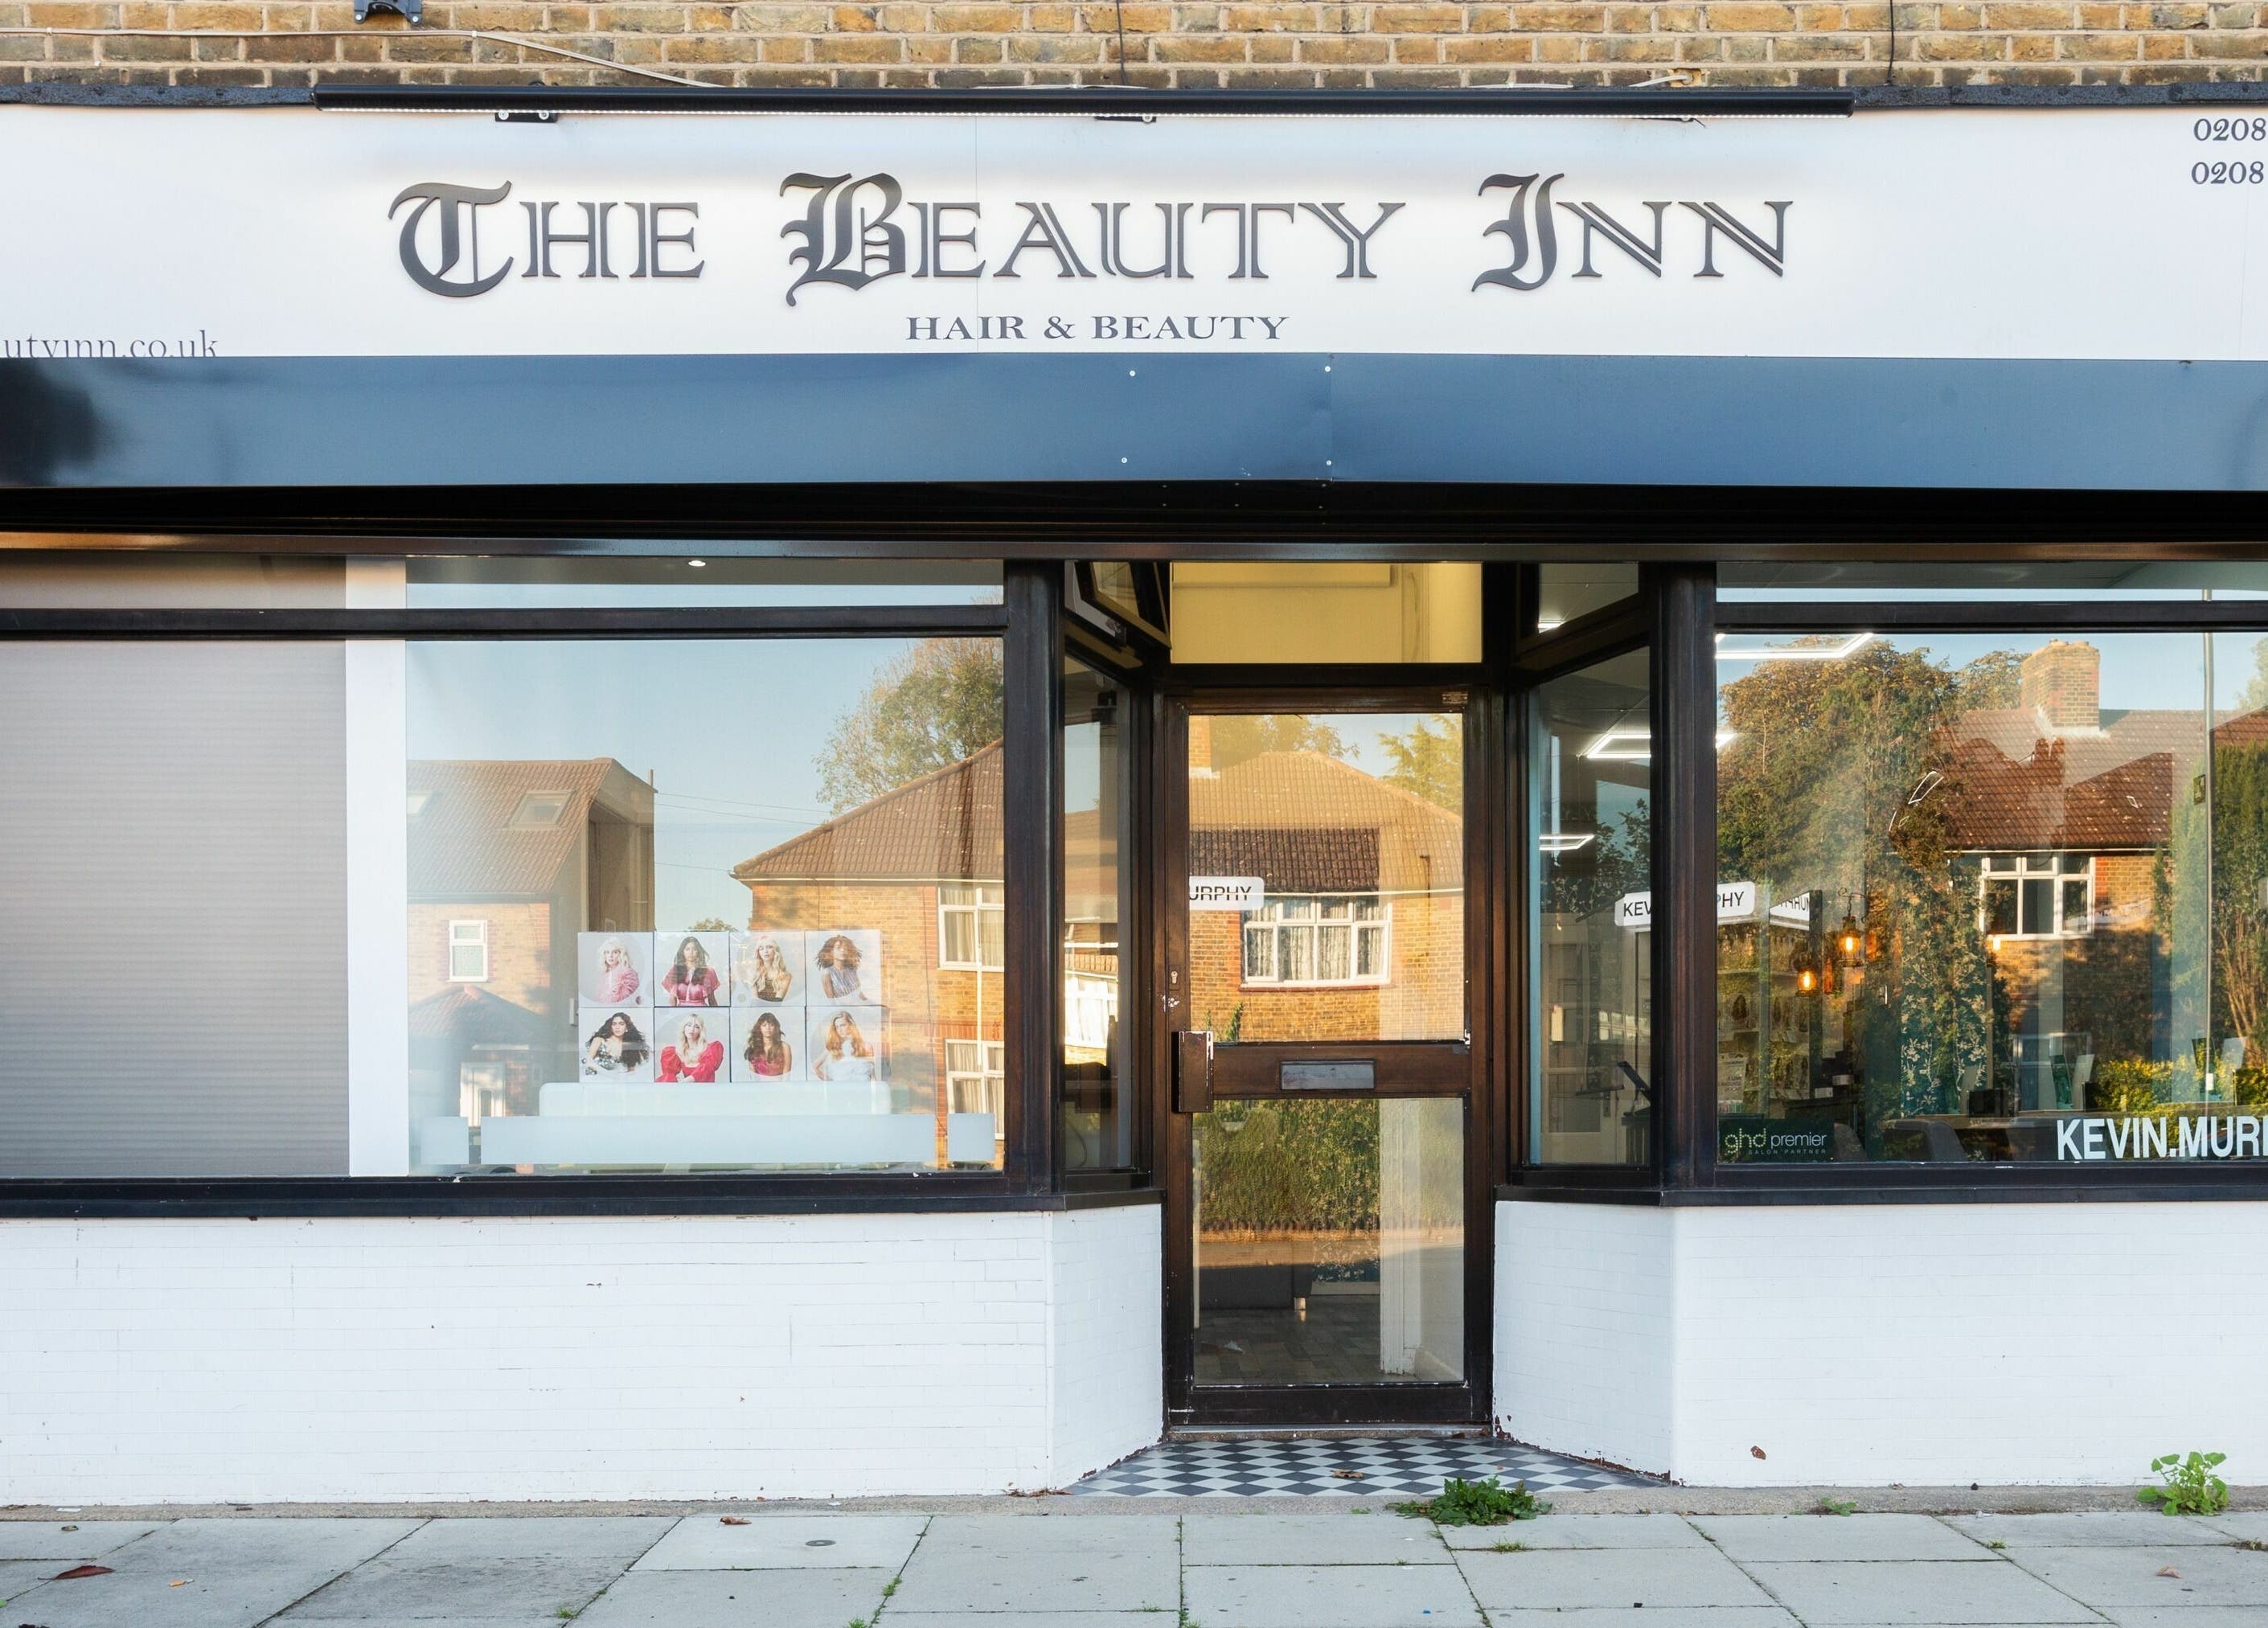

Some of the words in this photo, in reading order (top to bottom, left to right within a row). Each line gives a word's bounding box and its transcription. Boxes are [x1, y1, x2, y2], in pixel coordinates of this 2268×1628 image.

[2193, 117, 2266, 141] 0208
[2191, 161, 2264, 185] 0208
[906, 316, 1027, 340] HAIR
[1044, 316, 1076, 339] &
[1092, 316, 1287, 340] BEAUTY
[1724, 1127, 1767, 1154] ghd
[1770, 1131, 1827, 1150] premier
